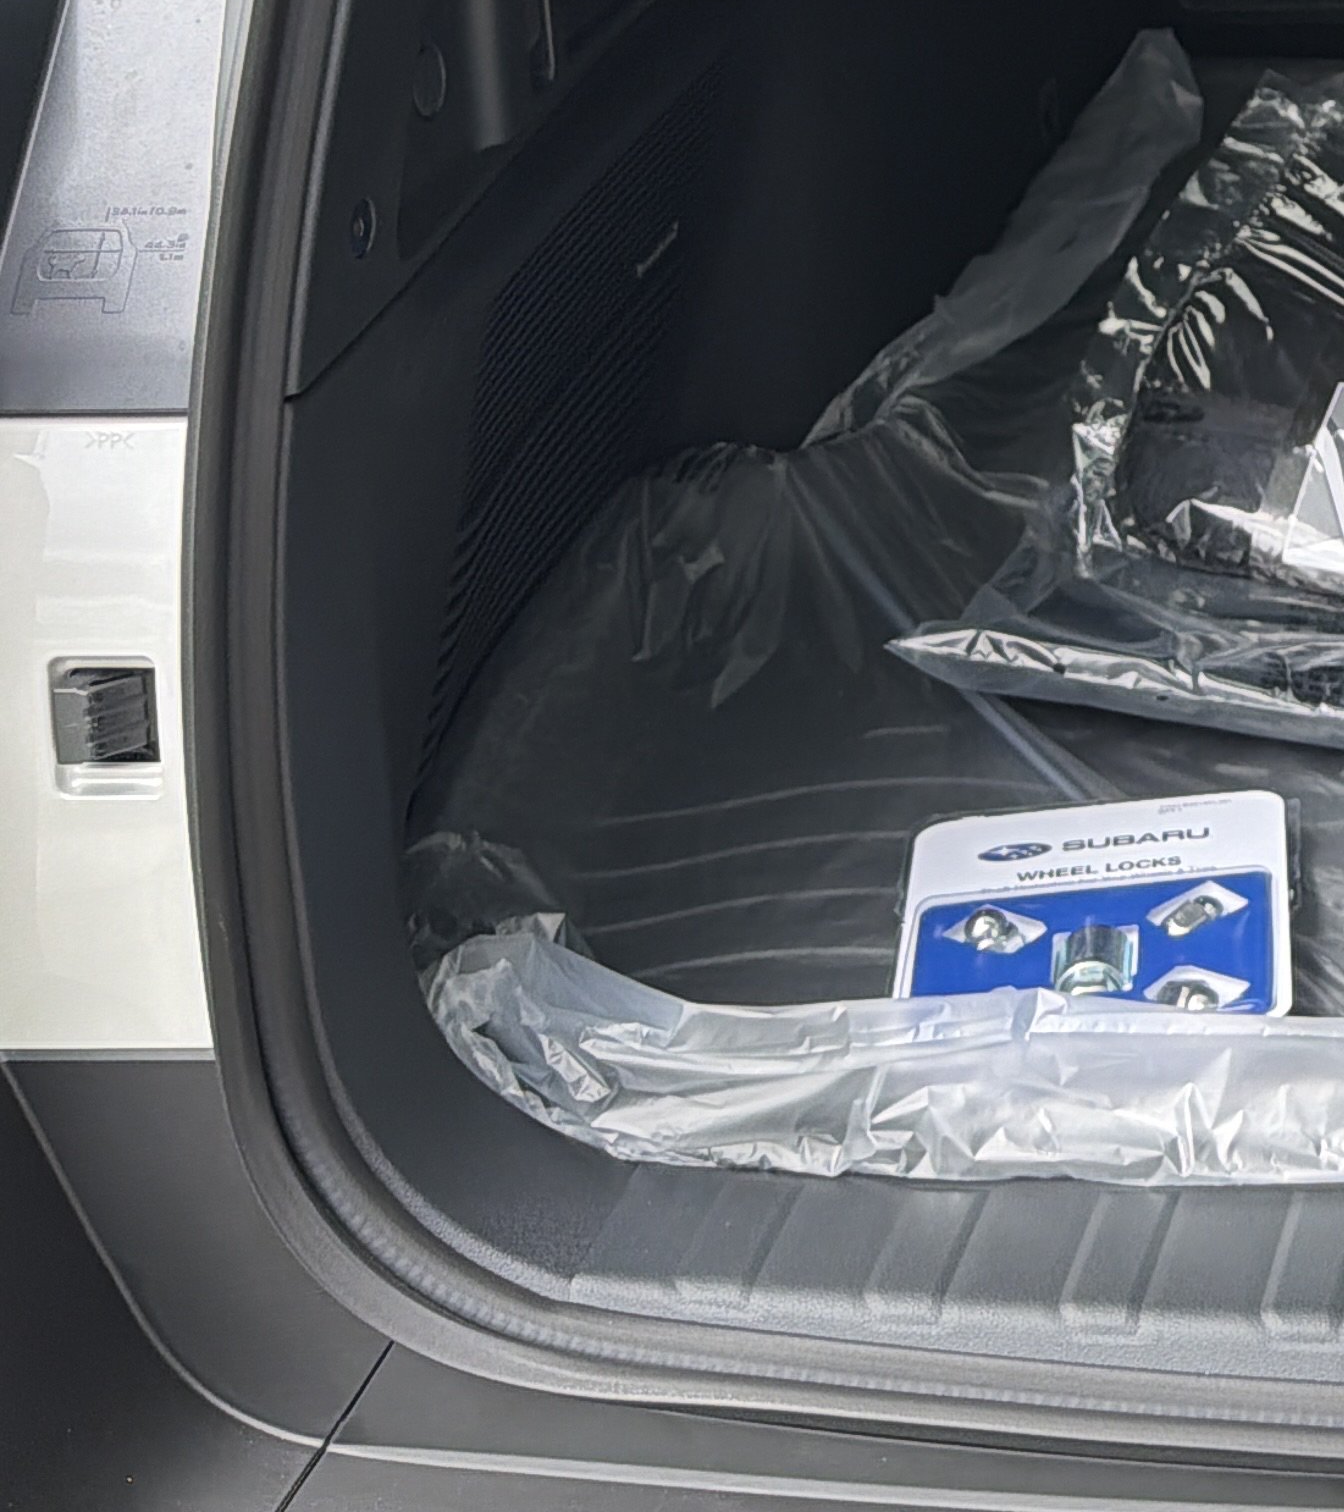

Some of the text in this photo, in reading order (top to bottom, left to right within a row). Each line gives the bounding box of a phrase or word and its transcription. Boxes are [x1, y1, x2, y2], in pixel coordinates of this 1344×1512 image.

[1062, 826, 1210, 852] SUBARU
[1017, 864, 1099, 882] WHEEL
[1105, 855, 1182, 873] LOCKS
